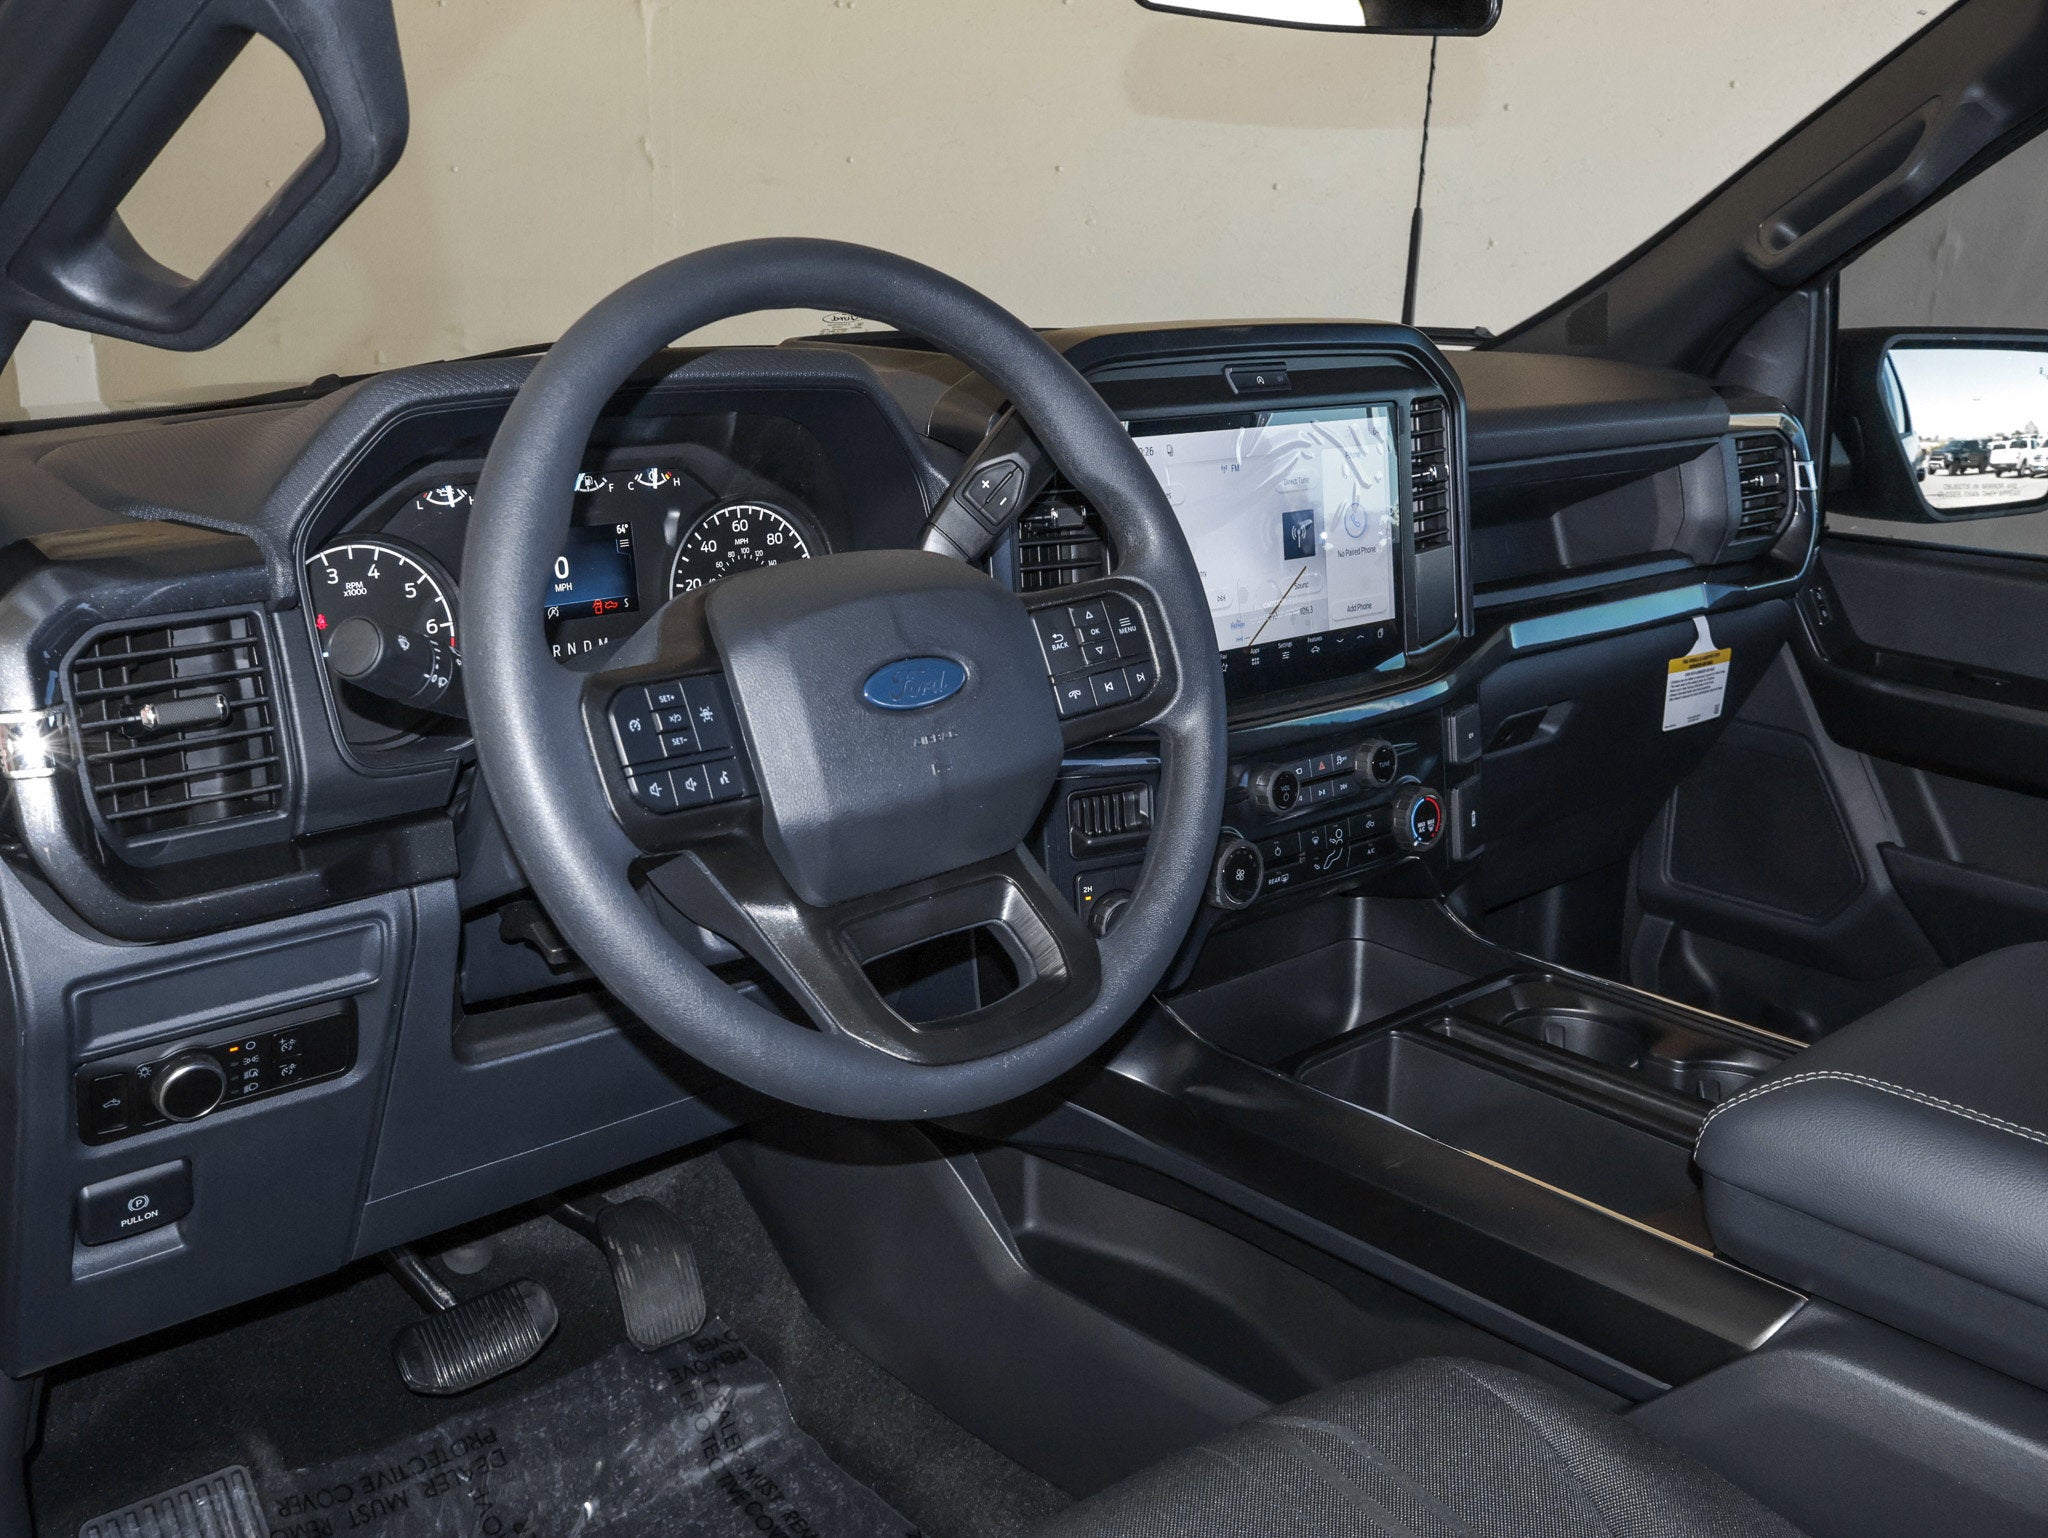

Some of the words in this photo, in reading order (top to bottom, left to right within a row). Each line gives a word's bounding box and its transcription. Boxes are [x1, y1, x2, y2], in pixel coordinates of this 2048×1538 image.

[627, 481, 635, 491] C
[673, 477, 681, 487] H
[608, 483, 615, 493] F
[416, 500, 424, 510] L
[731, 519, 749, 532] 60
[734, 537, 749, 546] MPH
[766, 532, 783, 545] 80
[700, 540, 717, 553] 40
[754, 549, 764, 557] 120
[1337, 550, 1345, 558] No
[553, 555, 570, 580] 0
[715, 561, 724, 569] 60
[326, 568, 339, 585] 3
[367, 563, 381, 580] 4
[345, 581, 364, 590] RPM
[404, 582, 417, 598] 5
[554, 582, 573, 593] MPH
[685, 578, 702, 592] 20
[343, 587, 368, 597] x1000
[1346, 603, 1357, 612] Add
[1357, 601, 1372, 610] Phone
[426, 618, 439, 634] 6
[1090, 627, 1100, 636] OK
[1118, 625, 1137, 635] MENU
[552, 644, 561, 658] R
[567, 642, 577, 656] N
[583, 640, 593, 652] D
[1051, 641, 1069, 652] BACK
[888, 667, 949, 703] Ford
[658, 694, 676, 703] SET+
[1082, 885, 1093, 893] 2H
[120, 1215, 144, 1228] PULL
[144, 1209, 159, 1220] ON
[357, 1426, 498, 1495] PROTECTIVE
[422, 1450, 508, 1500] DEALER
[277, 1483, 355, 1519] COVER
[349, 1490, 410, 1530] MUST
